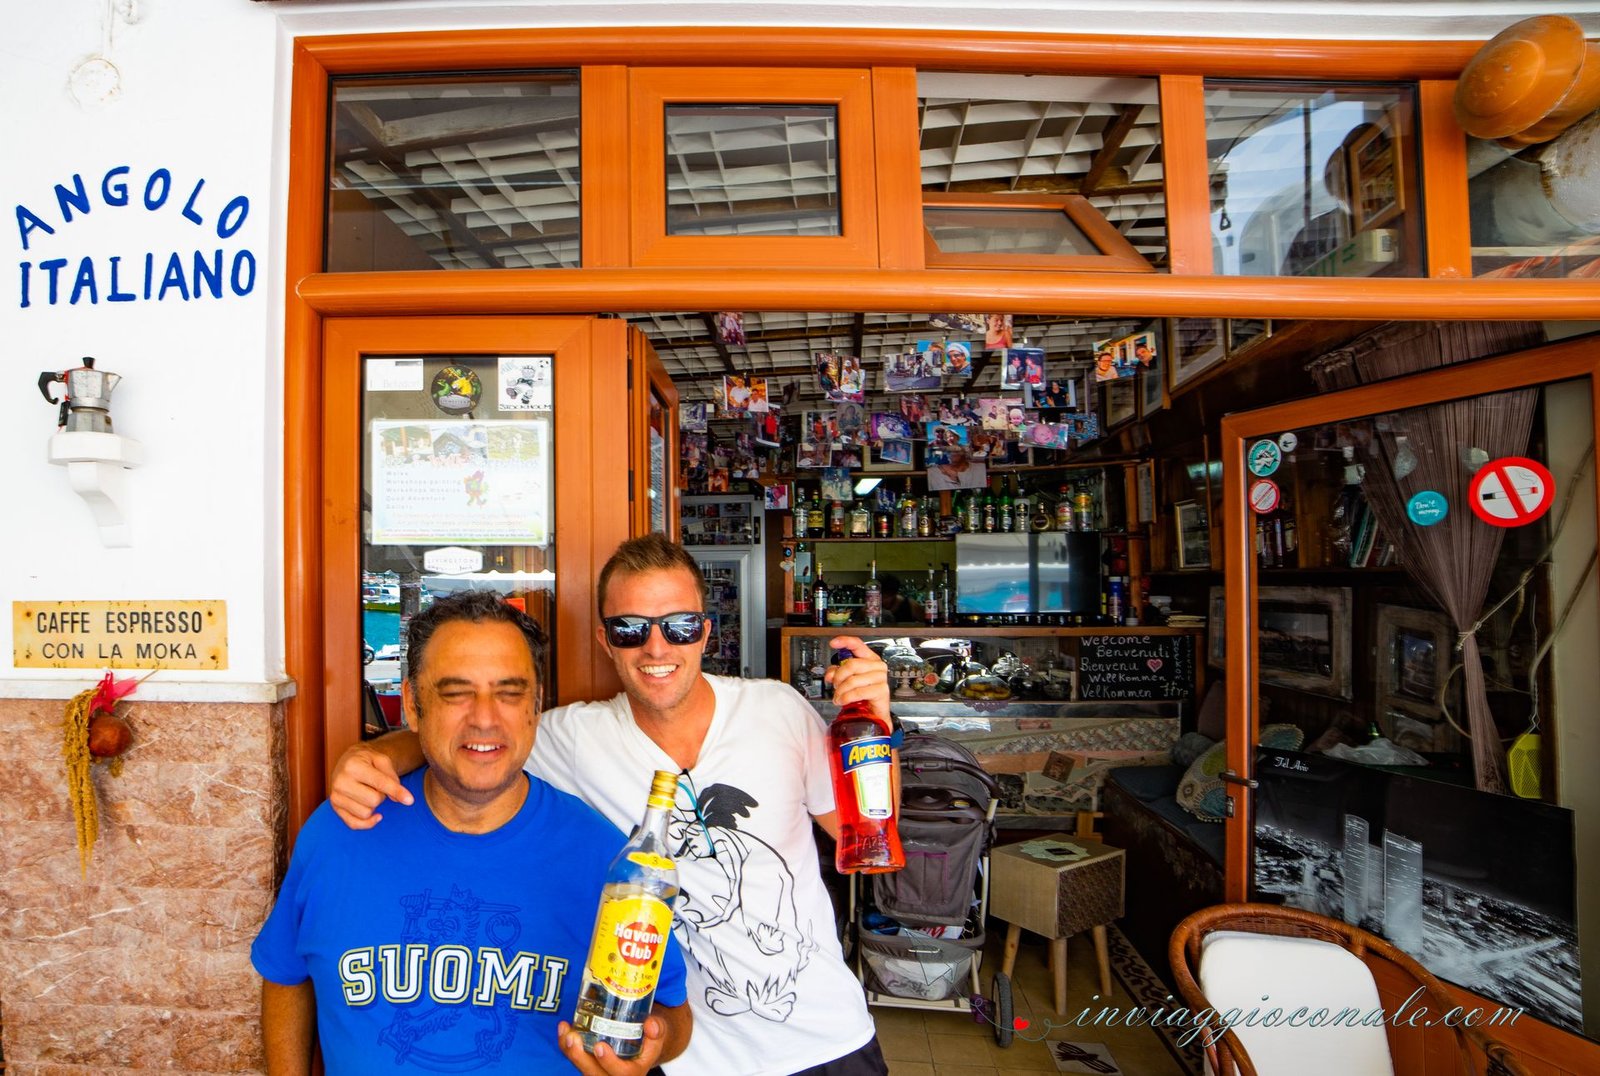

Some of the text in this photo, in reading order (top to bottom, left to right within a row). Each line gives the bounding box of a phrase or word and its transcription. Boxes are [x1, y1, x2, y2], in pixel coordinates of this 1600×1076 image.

[16, 165, 250, 250] ANGOLO
[20, 249, 256, 308] ITALIANO
[36, 610, 204, 634] CAFFE ESPRESSO
[42, 642, 198, 659] CON LA MOKA
[1080, 635, 1151, 647] Welcome
[1096, 644, 1170, 658] Benvenuti
[848, 744, 892, 766] APEROL
[614, 922, 664, 945] Havana
[621, 941, 652, 960] Club
[338, 943, 569, 1013] SUOMI
